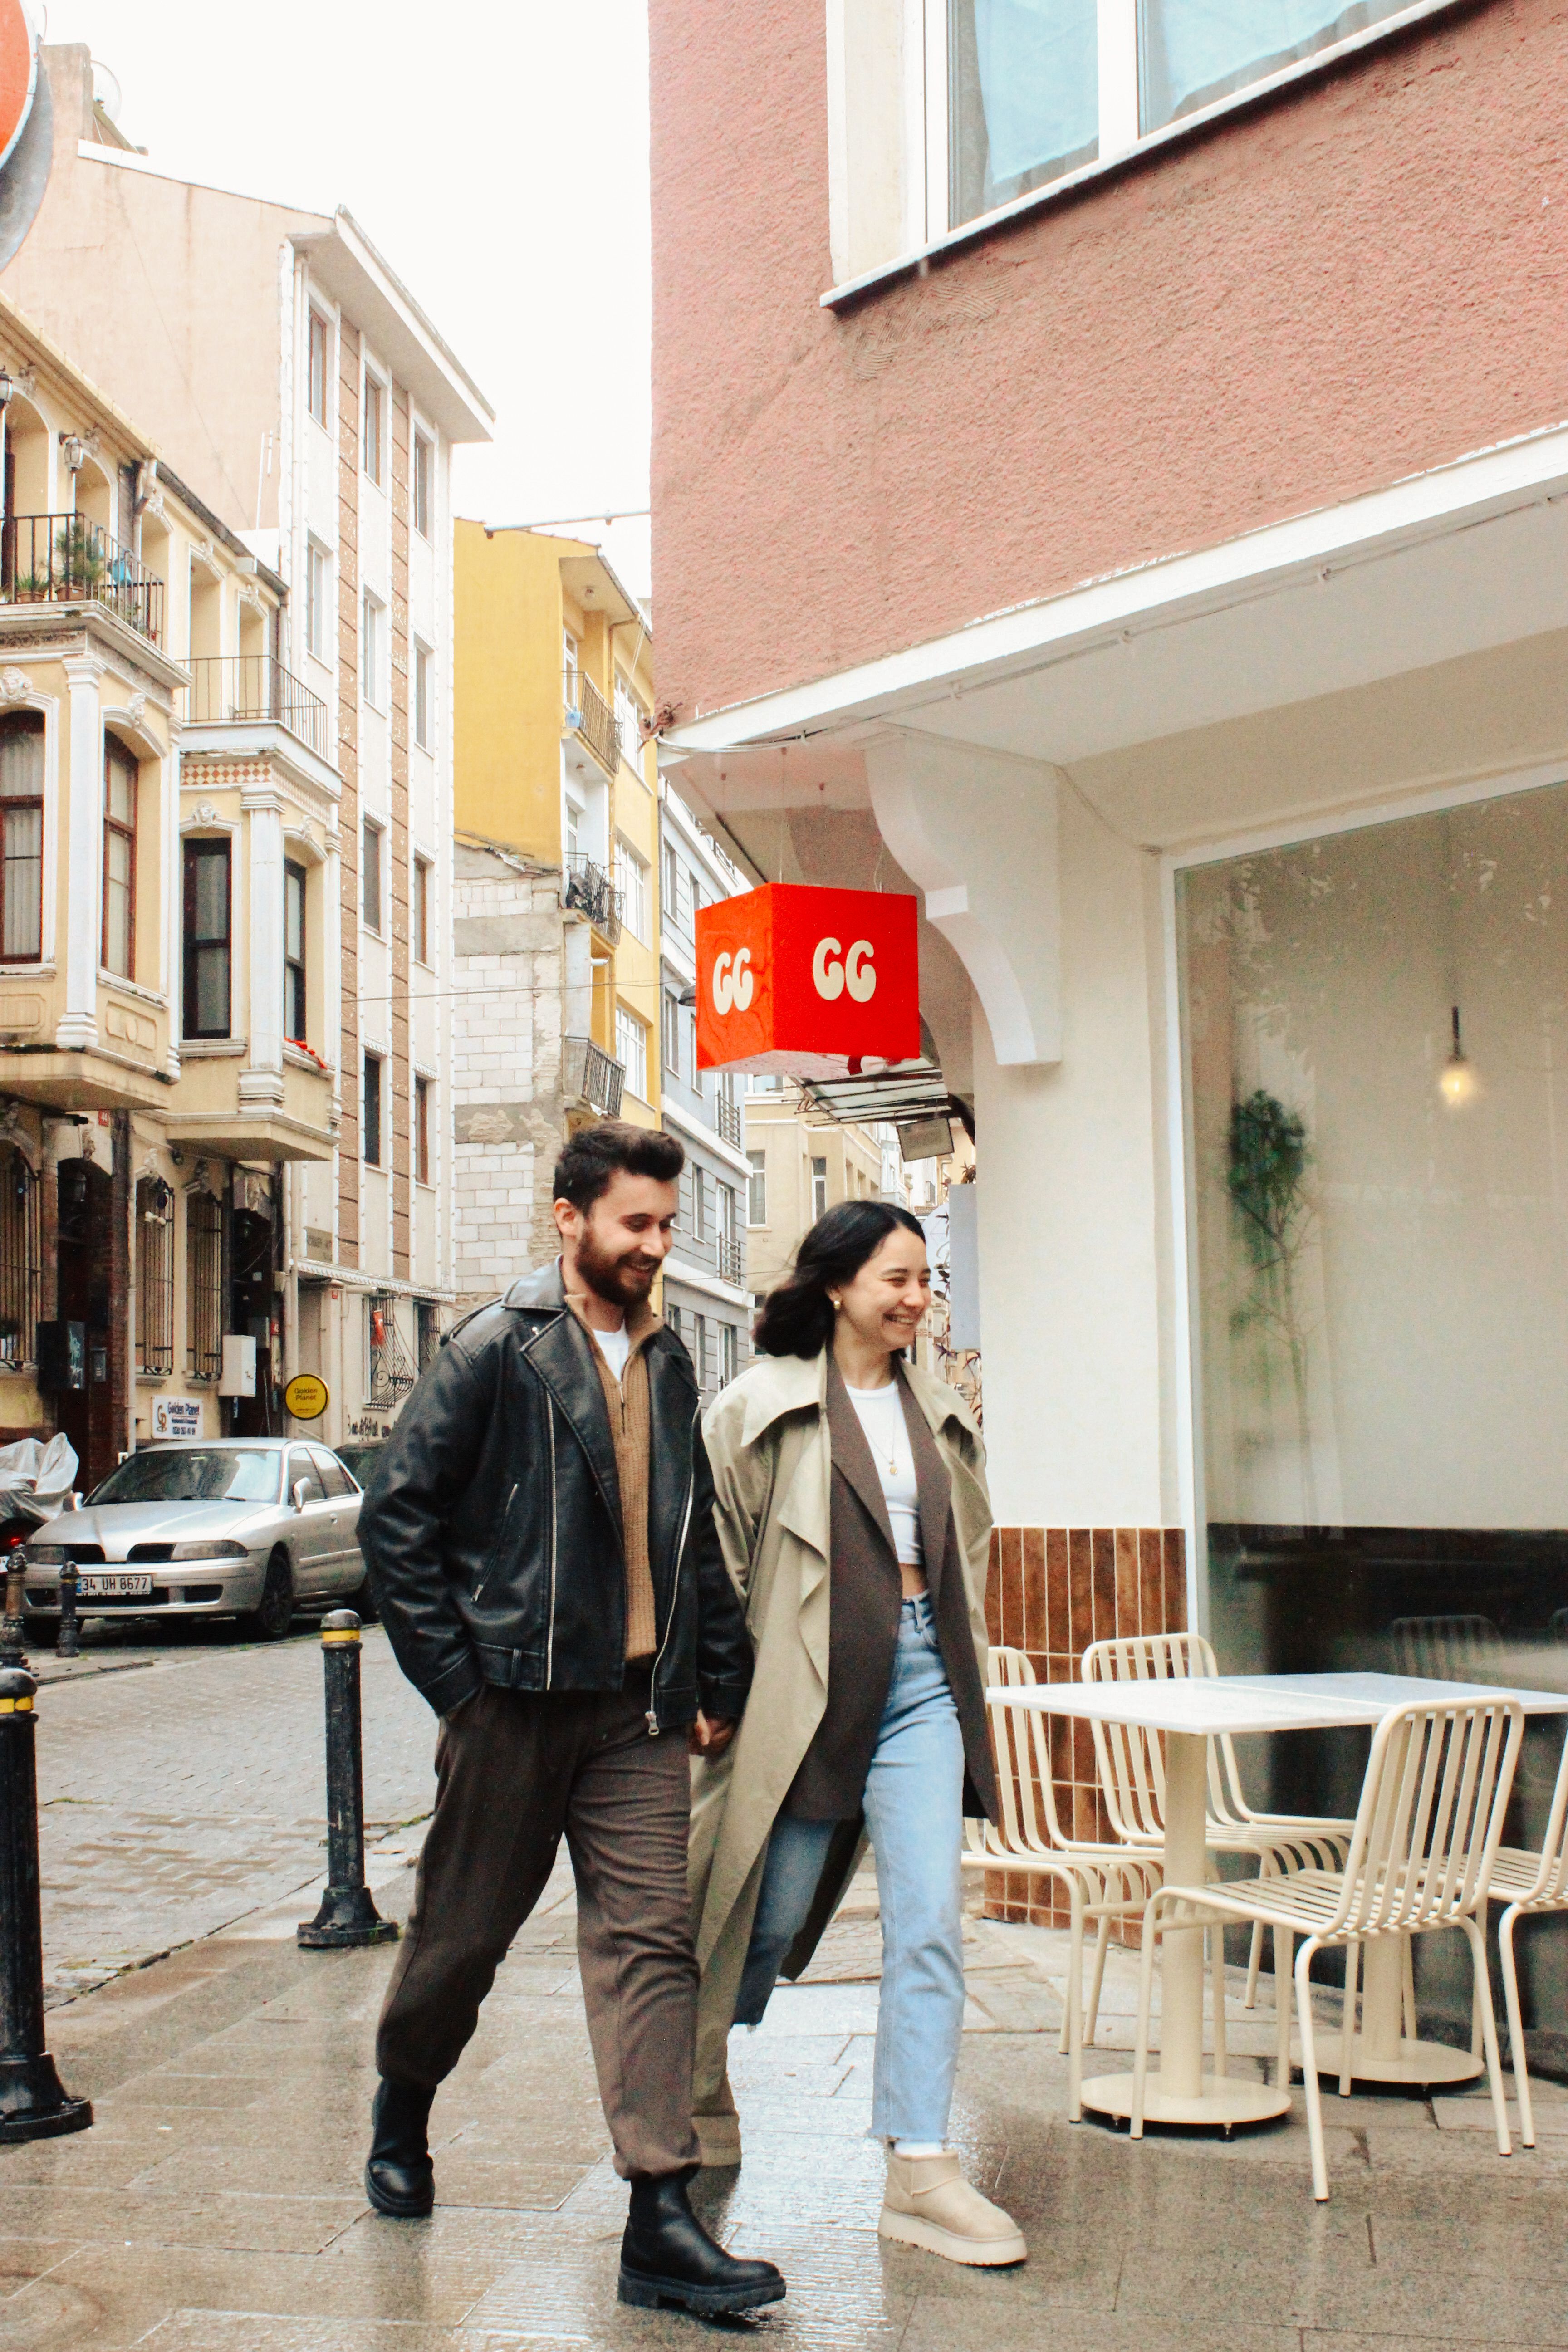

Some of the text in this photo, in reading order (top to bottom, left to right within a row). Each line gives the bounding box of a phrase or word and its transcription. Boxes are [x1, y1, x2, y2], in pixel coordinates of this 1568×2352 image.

[167, 1401, 200, 1416] Golden Planet
[83, 1577, 147, 1591] 34 UH 8677
